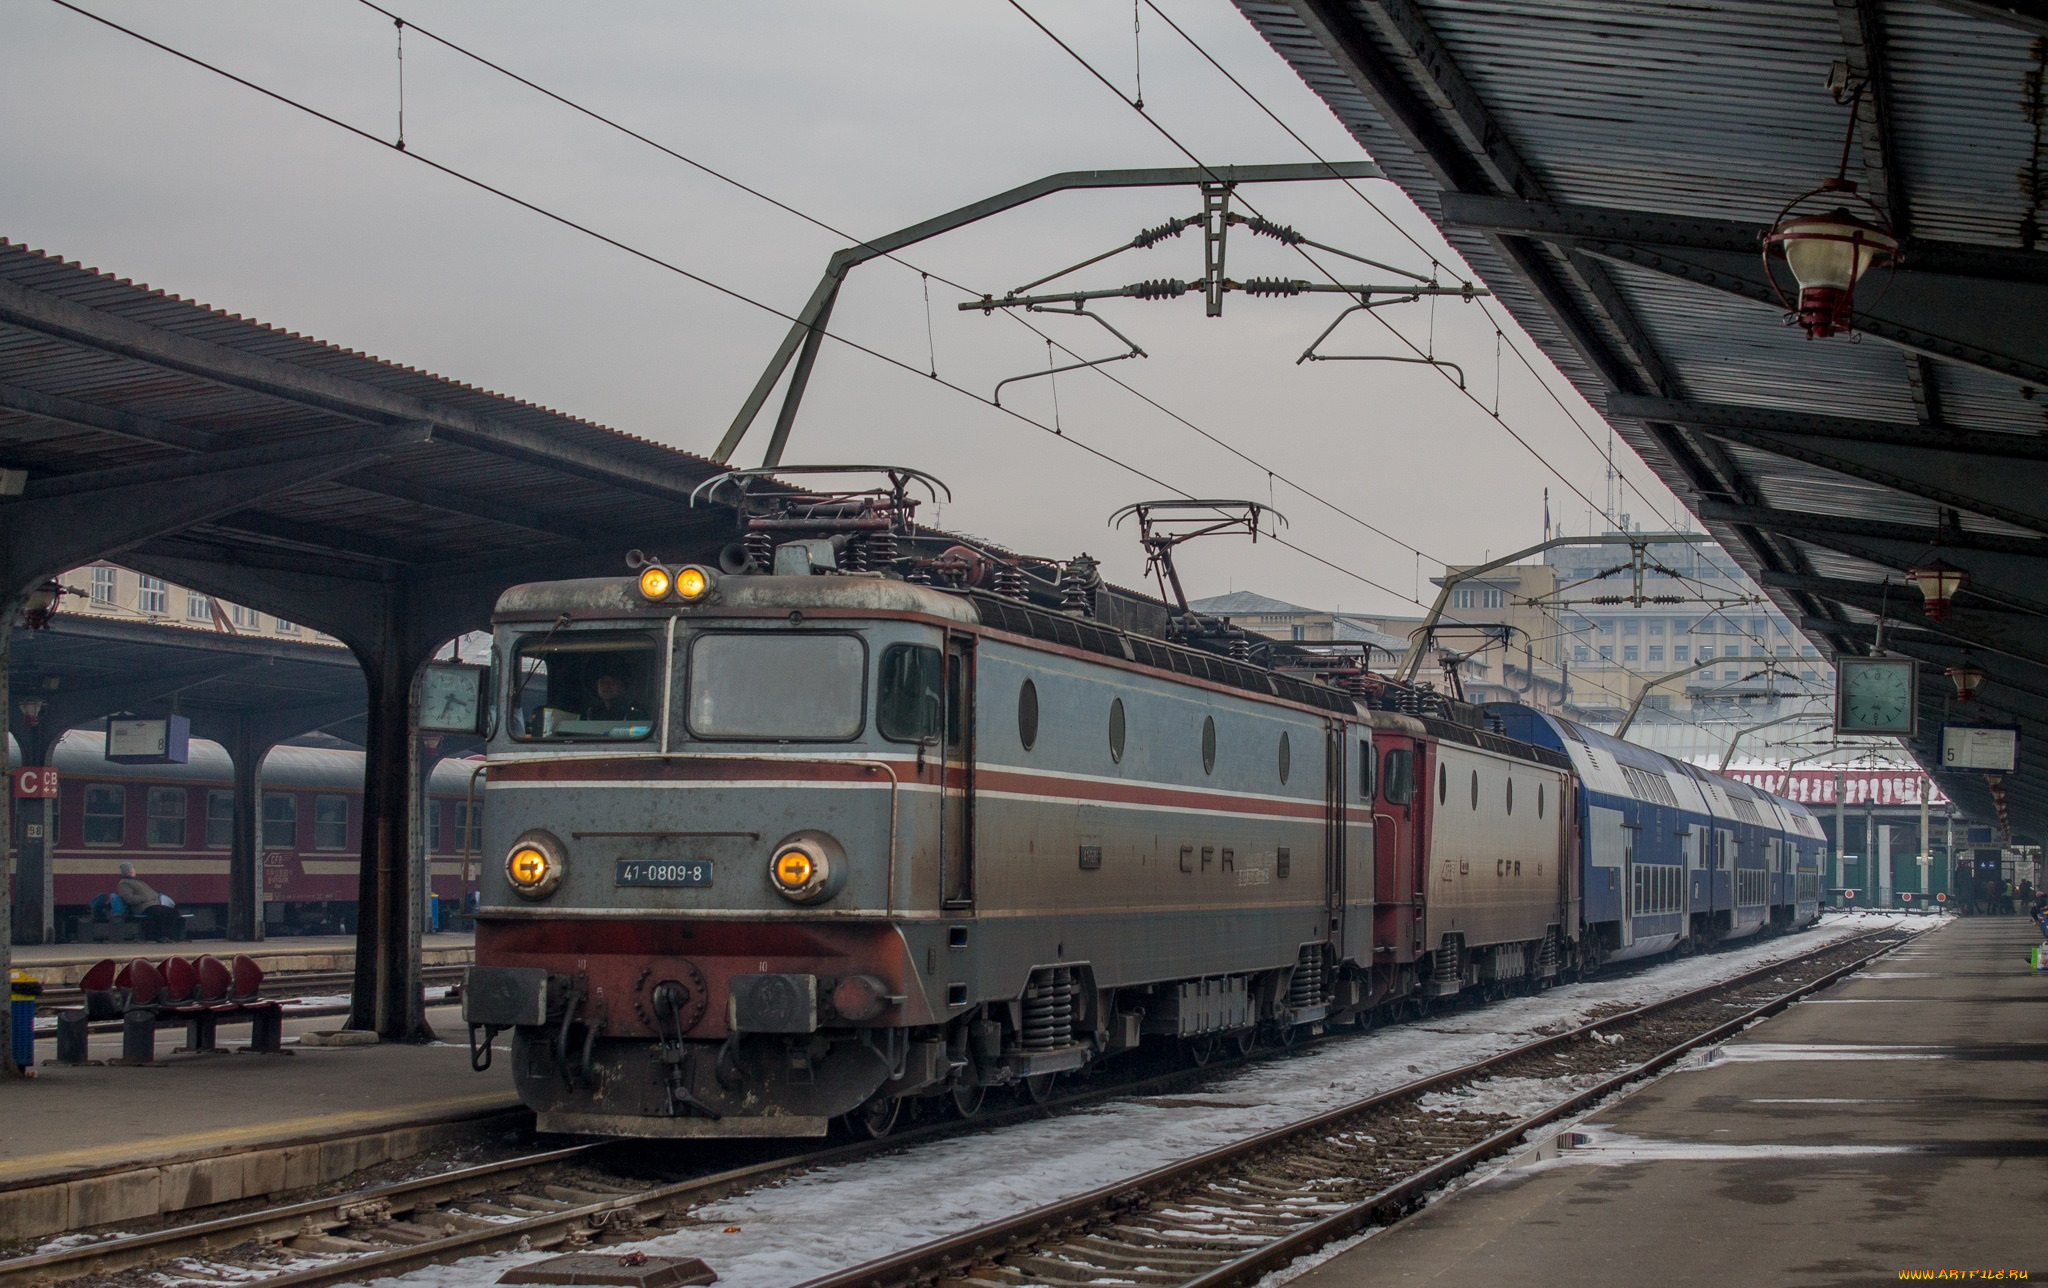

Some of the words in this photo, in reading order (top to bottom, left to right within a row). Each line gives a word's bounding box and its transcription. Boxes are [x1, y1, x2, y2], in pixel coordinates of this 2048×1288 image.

[158, 737, 164, 750] 8
[1947, 747, 1955, 761] 5
[21, 771, 37, 793] C
[1180, 845, 1234, 873] CFR
[623, 865, 702, 881] 41-0809-8
[1497, 859, 1520, 877] CFR
